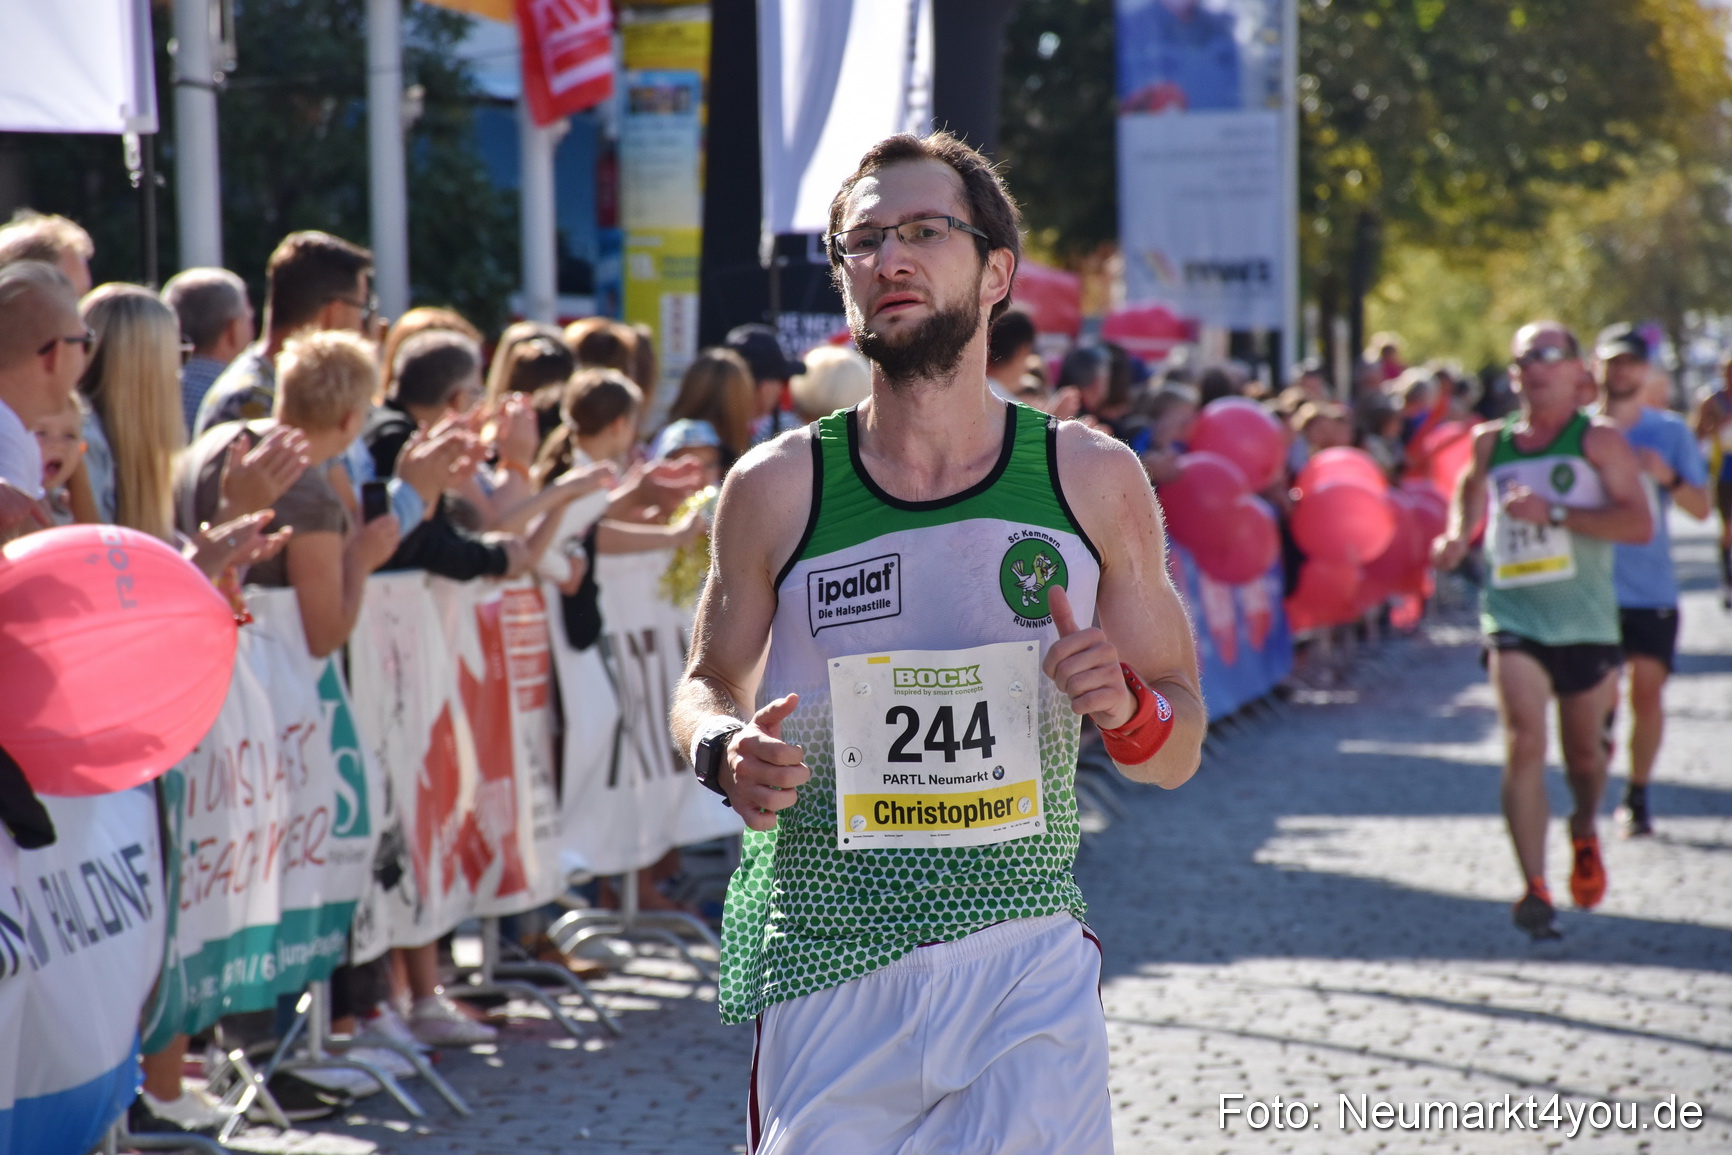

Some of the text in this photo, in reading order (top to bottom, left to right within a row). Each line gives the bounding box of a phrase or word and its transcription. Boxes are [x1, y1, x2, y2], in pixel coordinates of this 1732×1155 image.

[1008, 529, 1061, 549] SC Kemmern
[818, 598, 891, 619] Die Halspastille
[1013, 614, 1053, 629] RUNNING
[893, 664, 983, 688] BOCK
[894, 688, 922, 696] inspired
[923, 688, 932, 697] by
[954, 685, 984, 697] concepts
[885, 700, 996, 763] 244
[847, 751, 857, 763] A
[883, 771, 989, 786] PARTL Neumarkt
[873, 796, 1014, 828] Christopher
